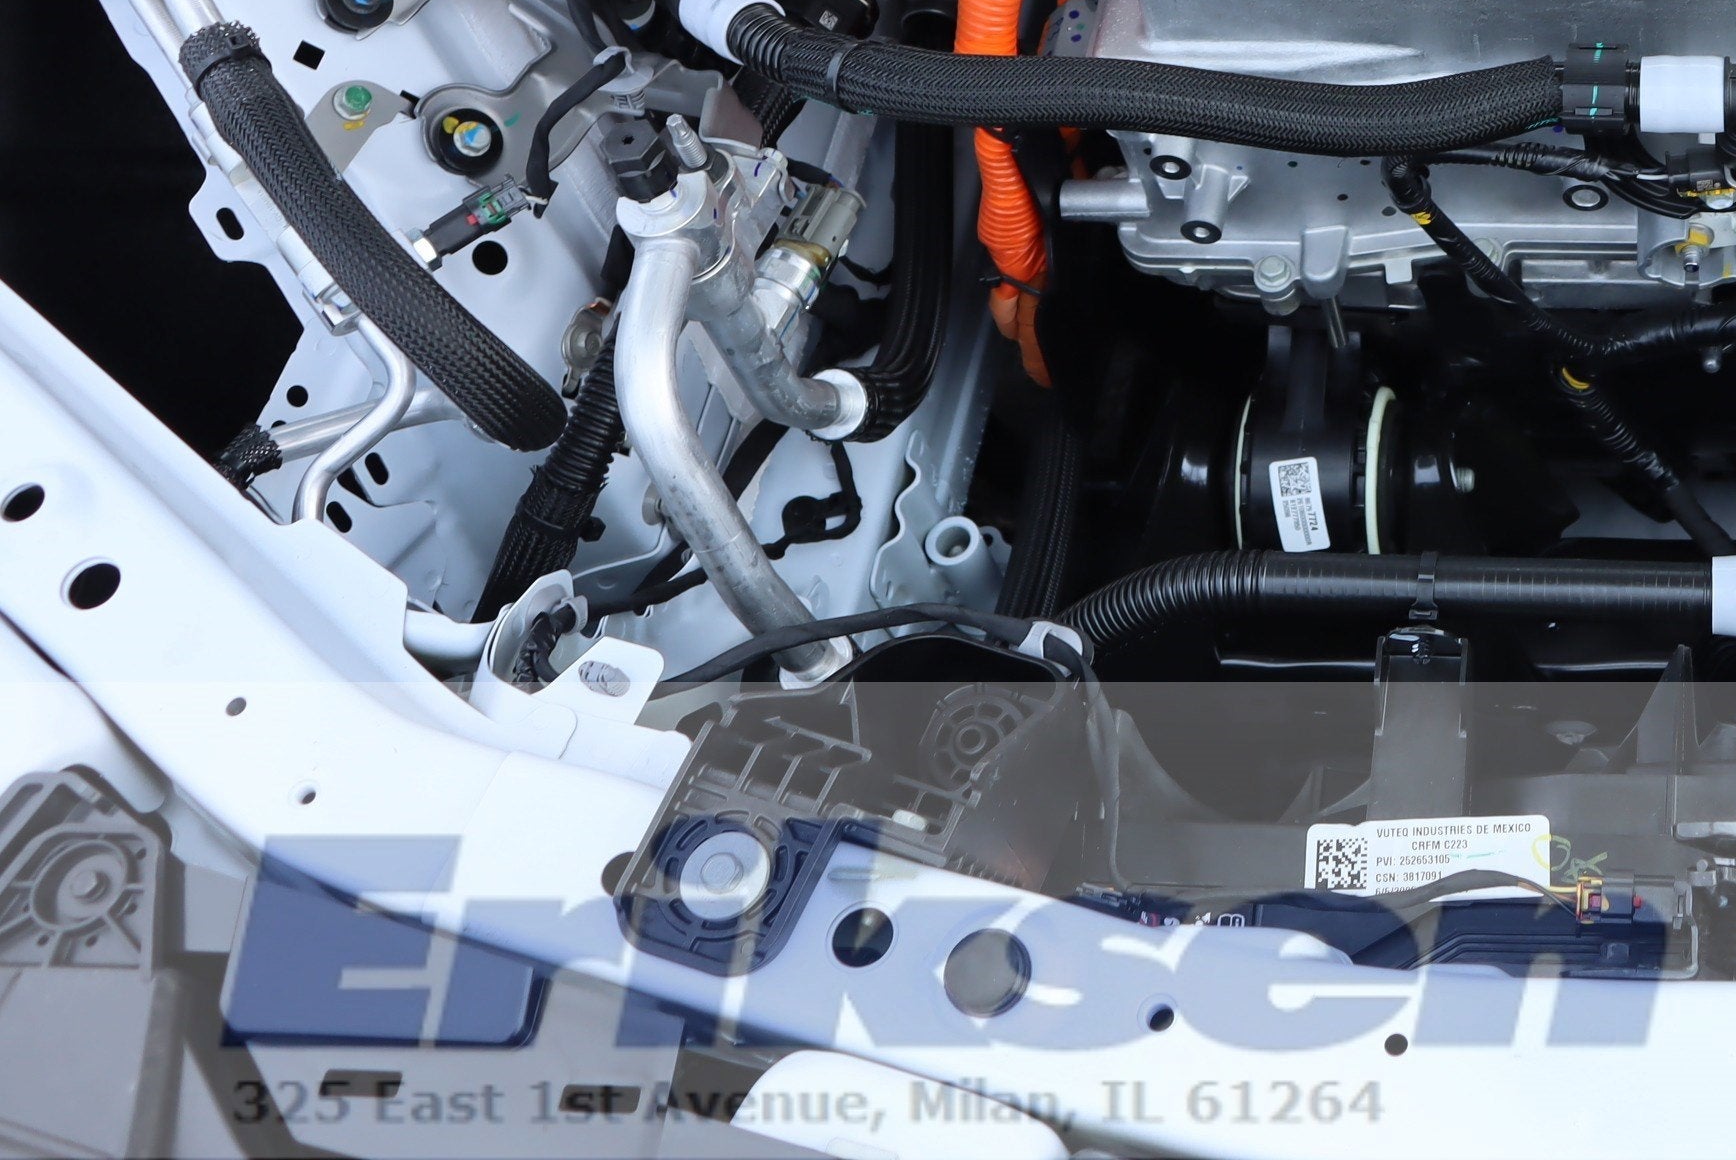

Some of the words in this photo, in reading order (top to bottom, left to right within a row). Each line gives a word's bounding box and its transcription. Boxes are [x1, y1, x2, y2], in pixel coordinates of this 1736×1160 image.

[1376, 828, 1409, 838] VUTEQ
[1412, 825, 1473, 837] INDUSTRIES
[1476, 824, 1488, 835] DE
[1493, 823, 1532, 834] MEXICO
[1411, 840, 1441, 851] CRFM
[1444, 839, 1469, 850] C223
[1376, 856, 1397, 866] PVI:
[1375, 872, 1399, 883] CSN:
[1403, 871, 1443, 882] 3817091
